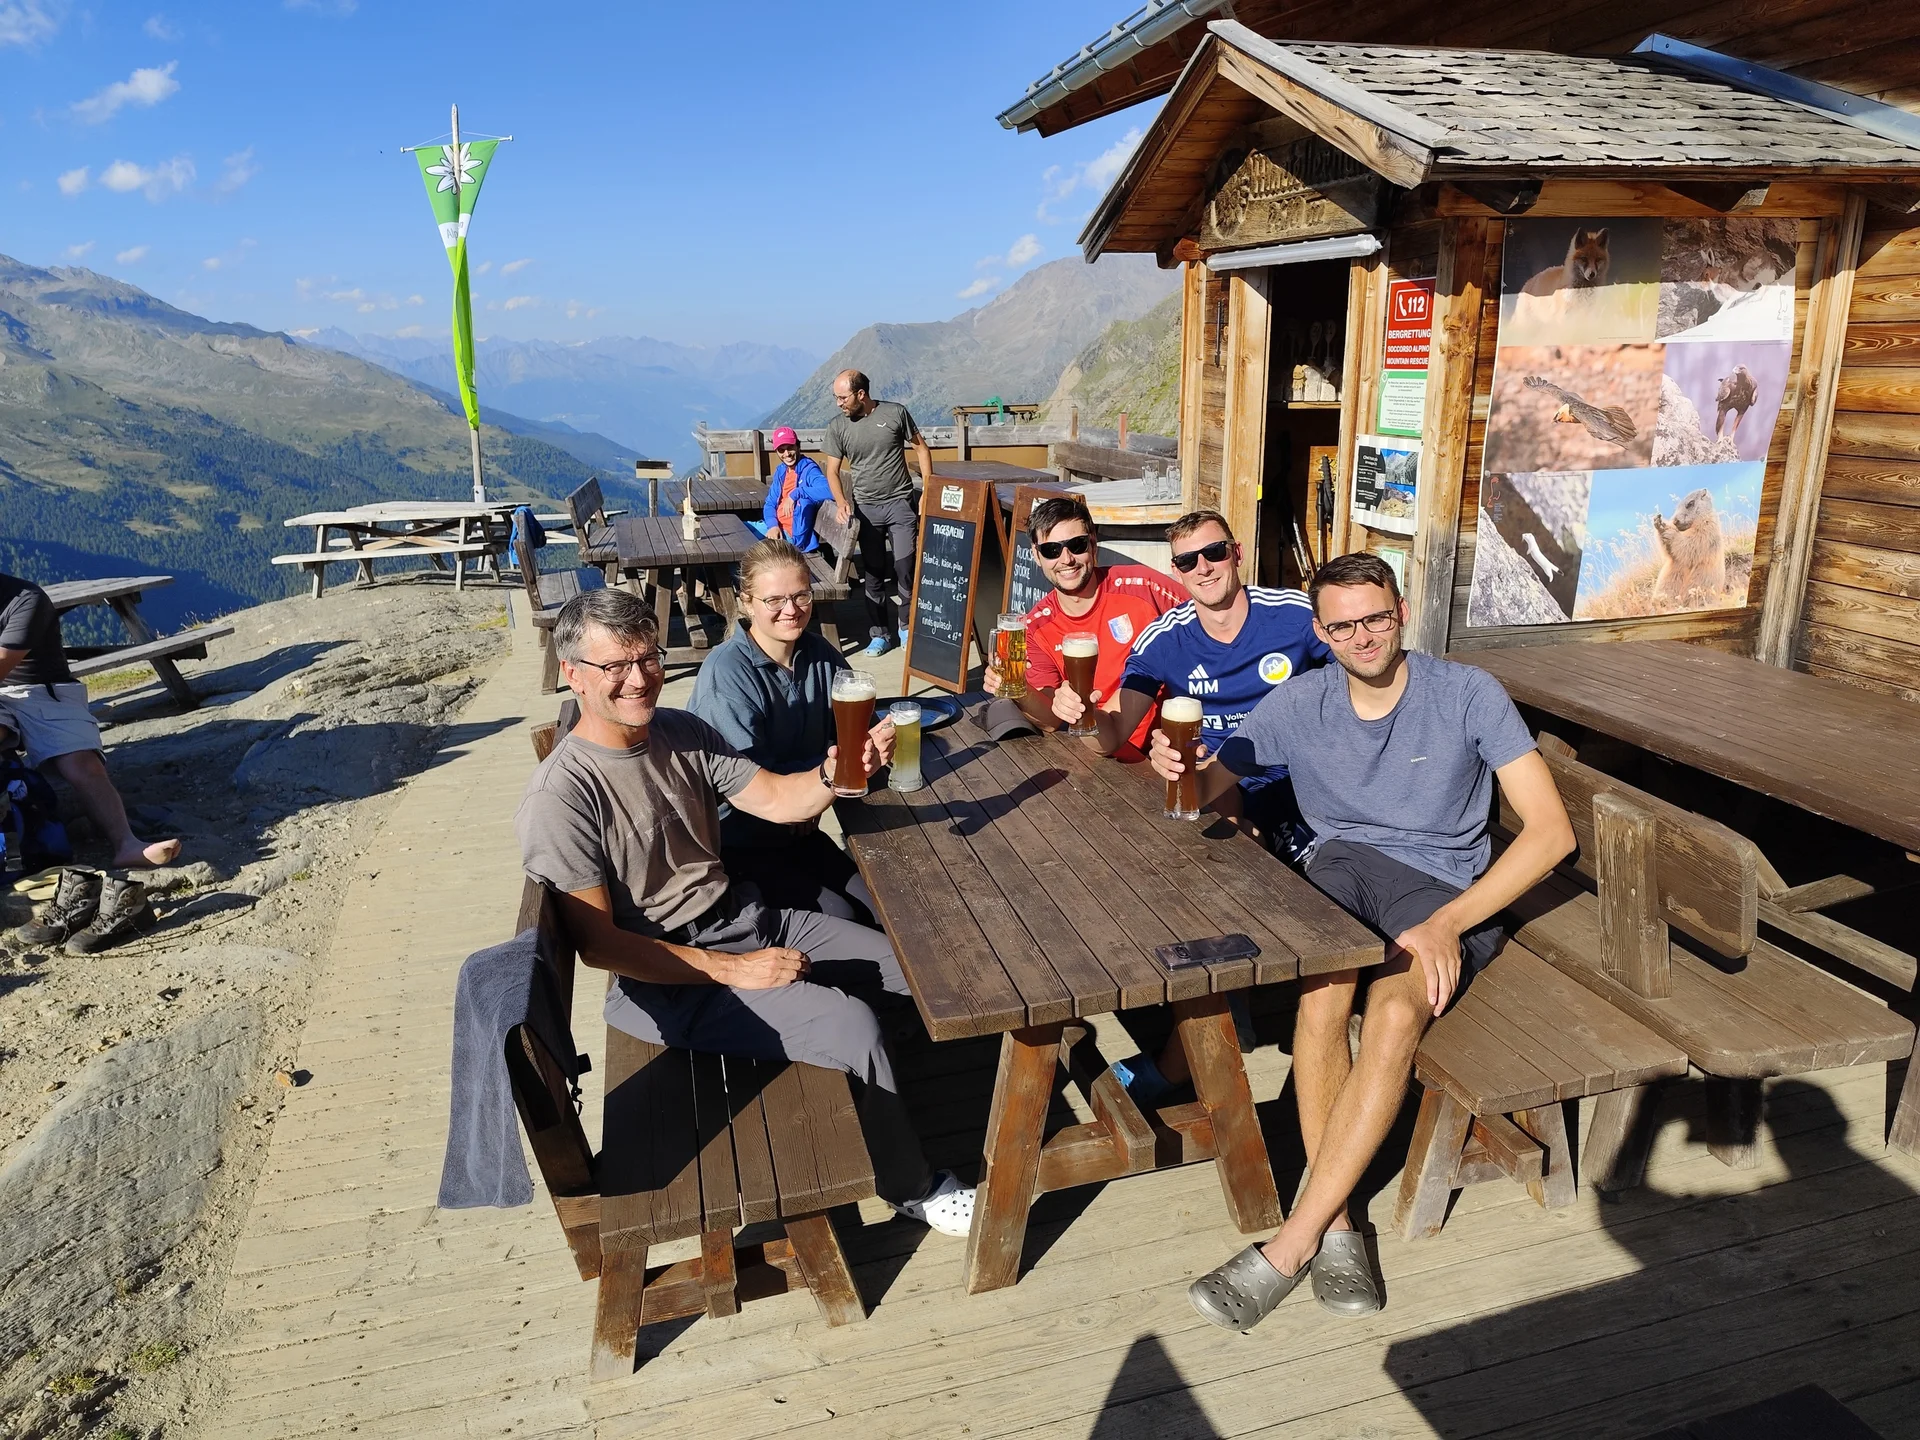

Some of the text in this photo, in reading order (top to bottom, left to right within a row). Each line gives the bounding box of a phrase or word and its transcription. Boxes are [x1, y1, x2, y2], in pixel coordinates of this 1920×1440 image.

[1407, 295, 1425, 313] 112
[1387, 328, 1431, 339] BERGRETTUNG
[1386, 344, 1430, 353] SOCCORSO ALPINO
[1386, 357, 1429, 365] MOUNTAIN RESCUE
[943, 492, 962, 504] FORST
[1188, 679, 1219, 695] MM
